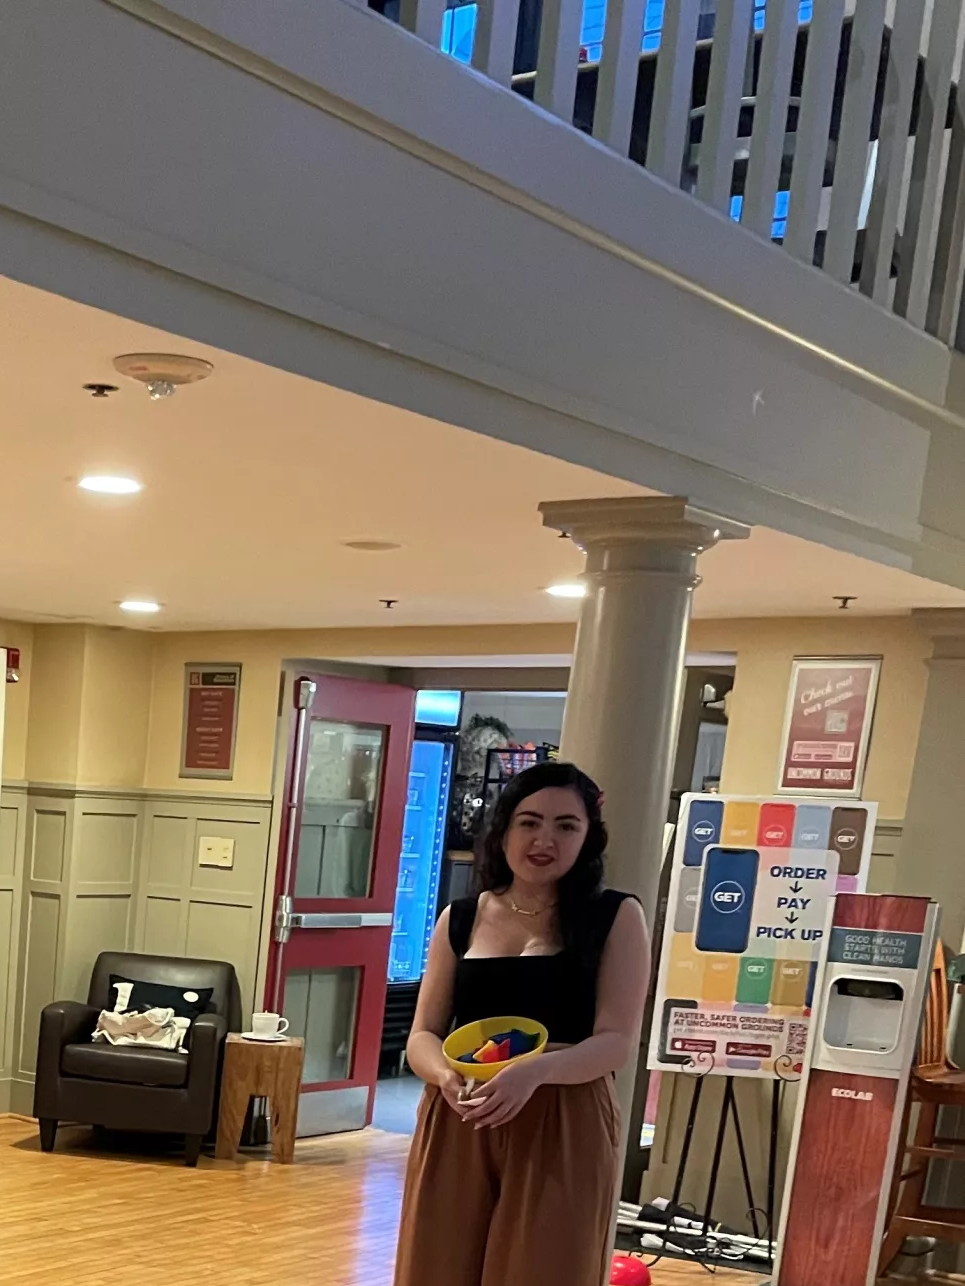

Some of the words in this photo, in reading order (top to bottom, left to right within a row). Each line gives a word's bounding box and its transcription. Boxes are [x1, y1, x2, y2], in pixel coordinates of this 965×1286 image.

[695, 827, 713, 836] GET
[837, 835, 856, 843] GET
[770, 865, 827, 880] ORDER
[714, 891, 741, 903] GET
[777, 897, 811, 910] PAY
[756, 926, 796, 940] PICK
[800, 929, 823, 941] UP
[845, 934, 870, 944] GOOD
[872, 936, 907, 947] HEALTH
[880, 946, 905, 955] WITH
[842, 952, 871, 961] CLEAN
[872, 954, 904, 965] HANDS
[747, 965, 765, 973] GET
[674, 1011, 707, 1020] FASTER,
[710, 1014, 737, 1022] SAFER
[739, 1016, 785, 1026] ORDERING
[674, 1018, 684, 1026] AT
[686, 1019, 739, 1030] UNCOMMON
[741, 1023, 784, 1033] GROUNDS
[831, 1087, 874, 1101] ECOLAB
